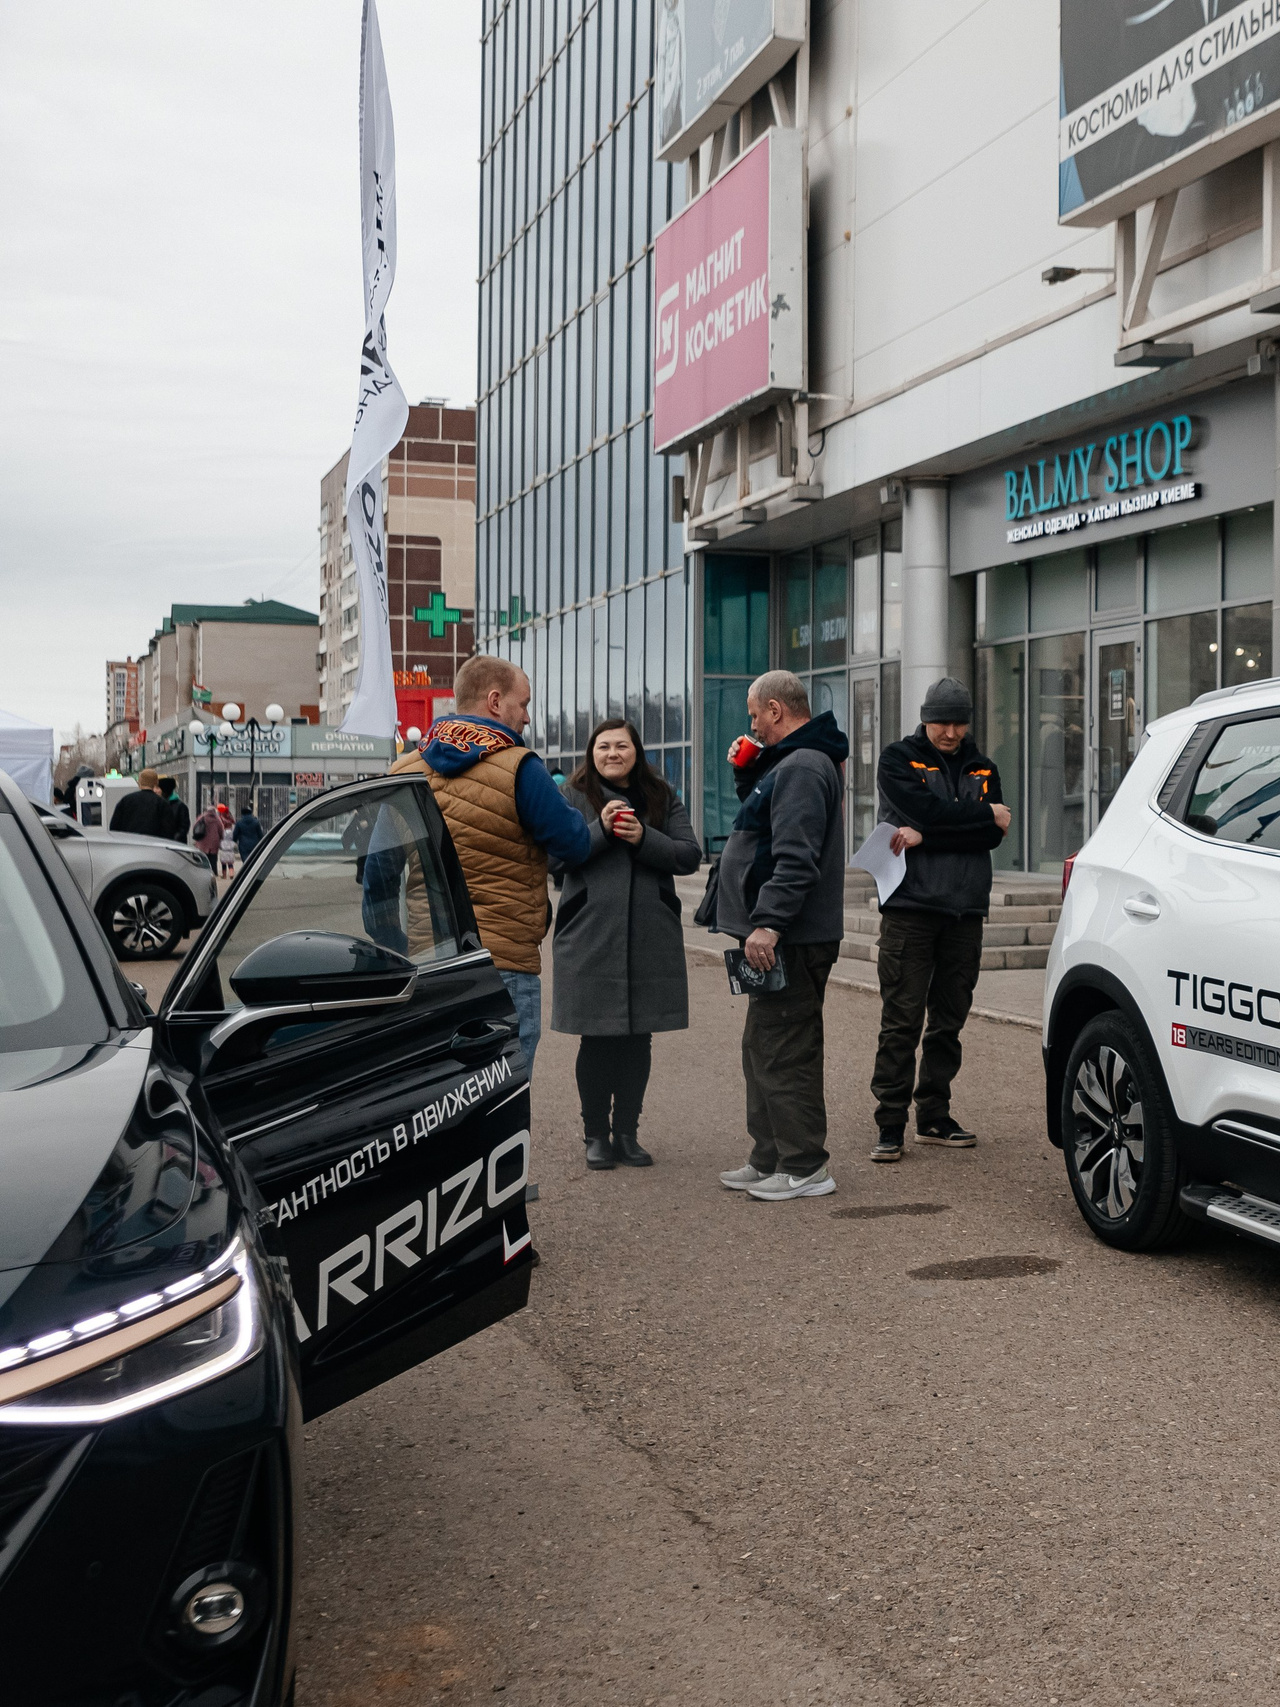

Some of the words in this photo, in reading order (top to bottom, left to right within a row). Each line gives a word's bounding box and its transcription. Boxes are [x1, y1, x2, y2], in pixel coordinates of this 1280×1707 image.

[1068, 76, 1153, 149] КОСТЮМЫ
[1157, 48, 1194, 99] ДЛЯ
[686, 227, 745, 310] МАГНИТ
[685, 273, 767, 367] КОСМЕТИК
[1004, 443, 1097, 521] BALMY
[1104, 414, 1193, 493] SHOP
[1007, 521, 1044, 543] ЖЕНСКАЯ
[1044, 512, 1081, 535] ОДЕЖДА
[1087, 503, 1120, 524] ХАТЫН
[1121, 490, 1160, 516] КЫЗЛАР
[1160, 482, 1196, 505] КИЕМЕ
[311, 742, 374, 752] ПЕРЧАТКИ
[1172, 1026, 1186, 1046] 18
[1188, 1028, 1234, 1056] YEARS
[393, 1122, 408, 1152] В
[413, 1055, 513, 1144] ДВИЖЕНИИ
